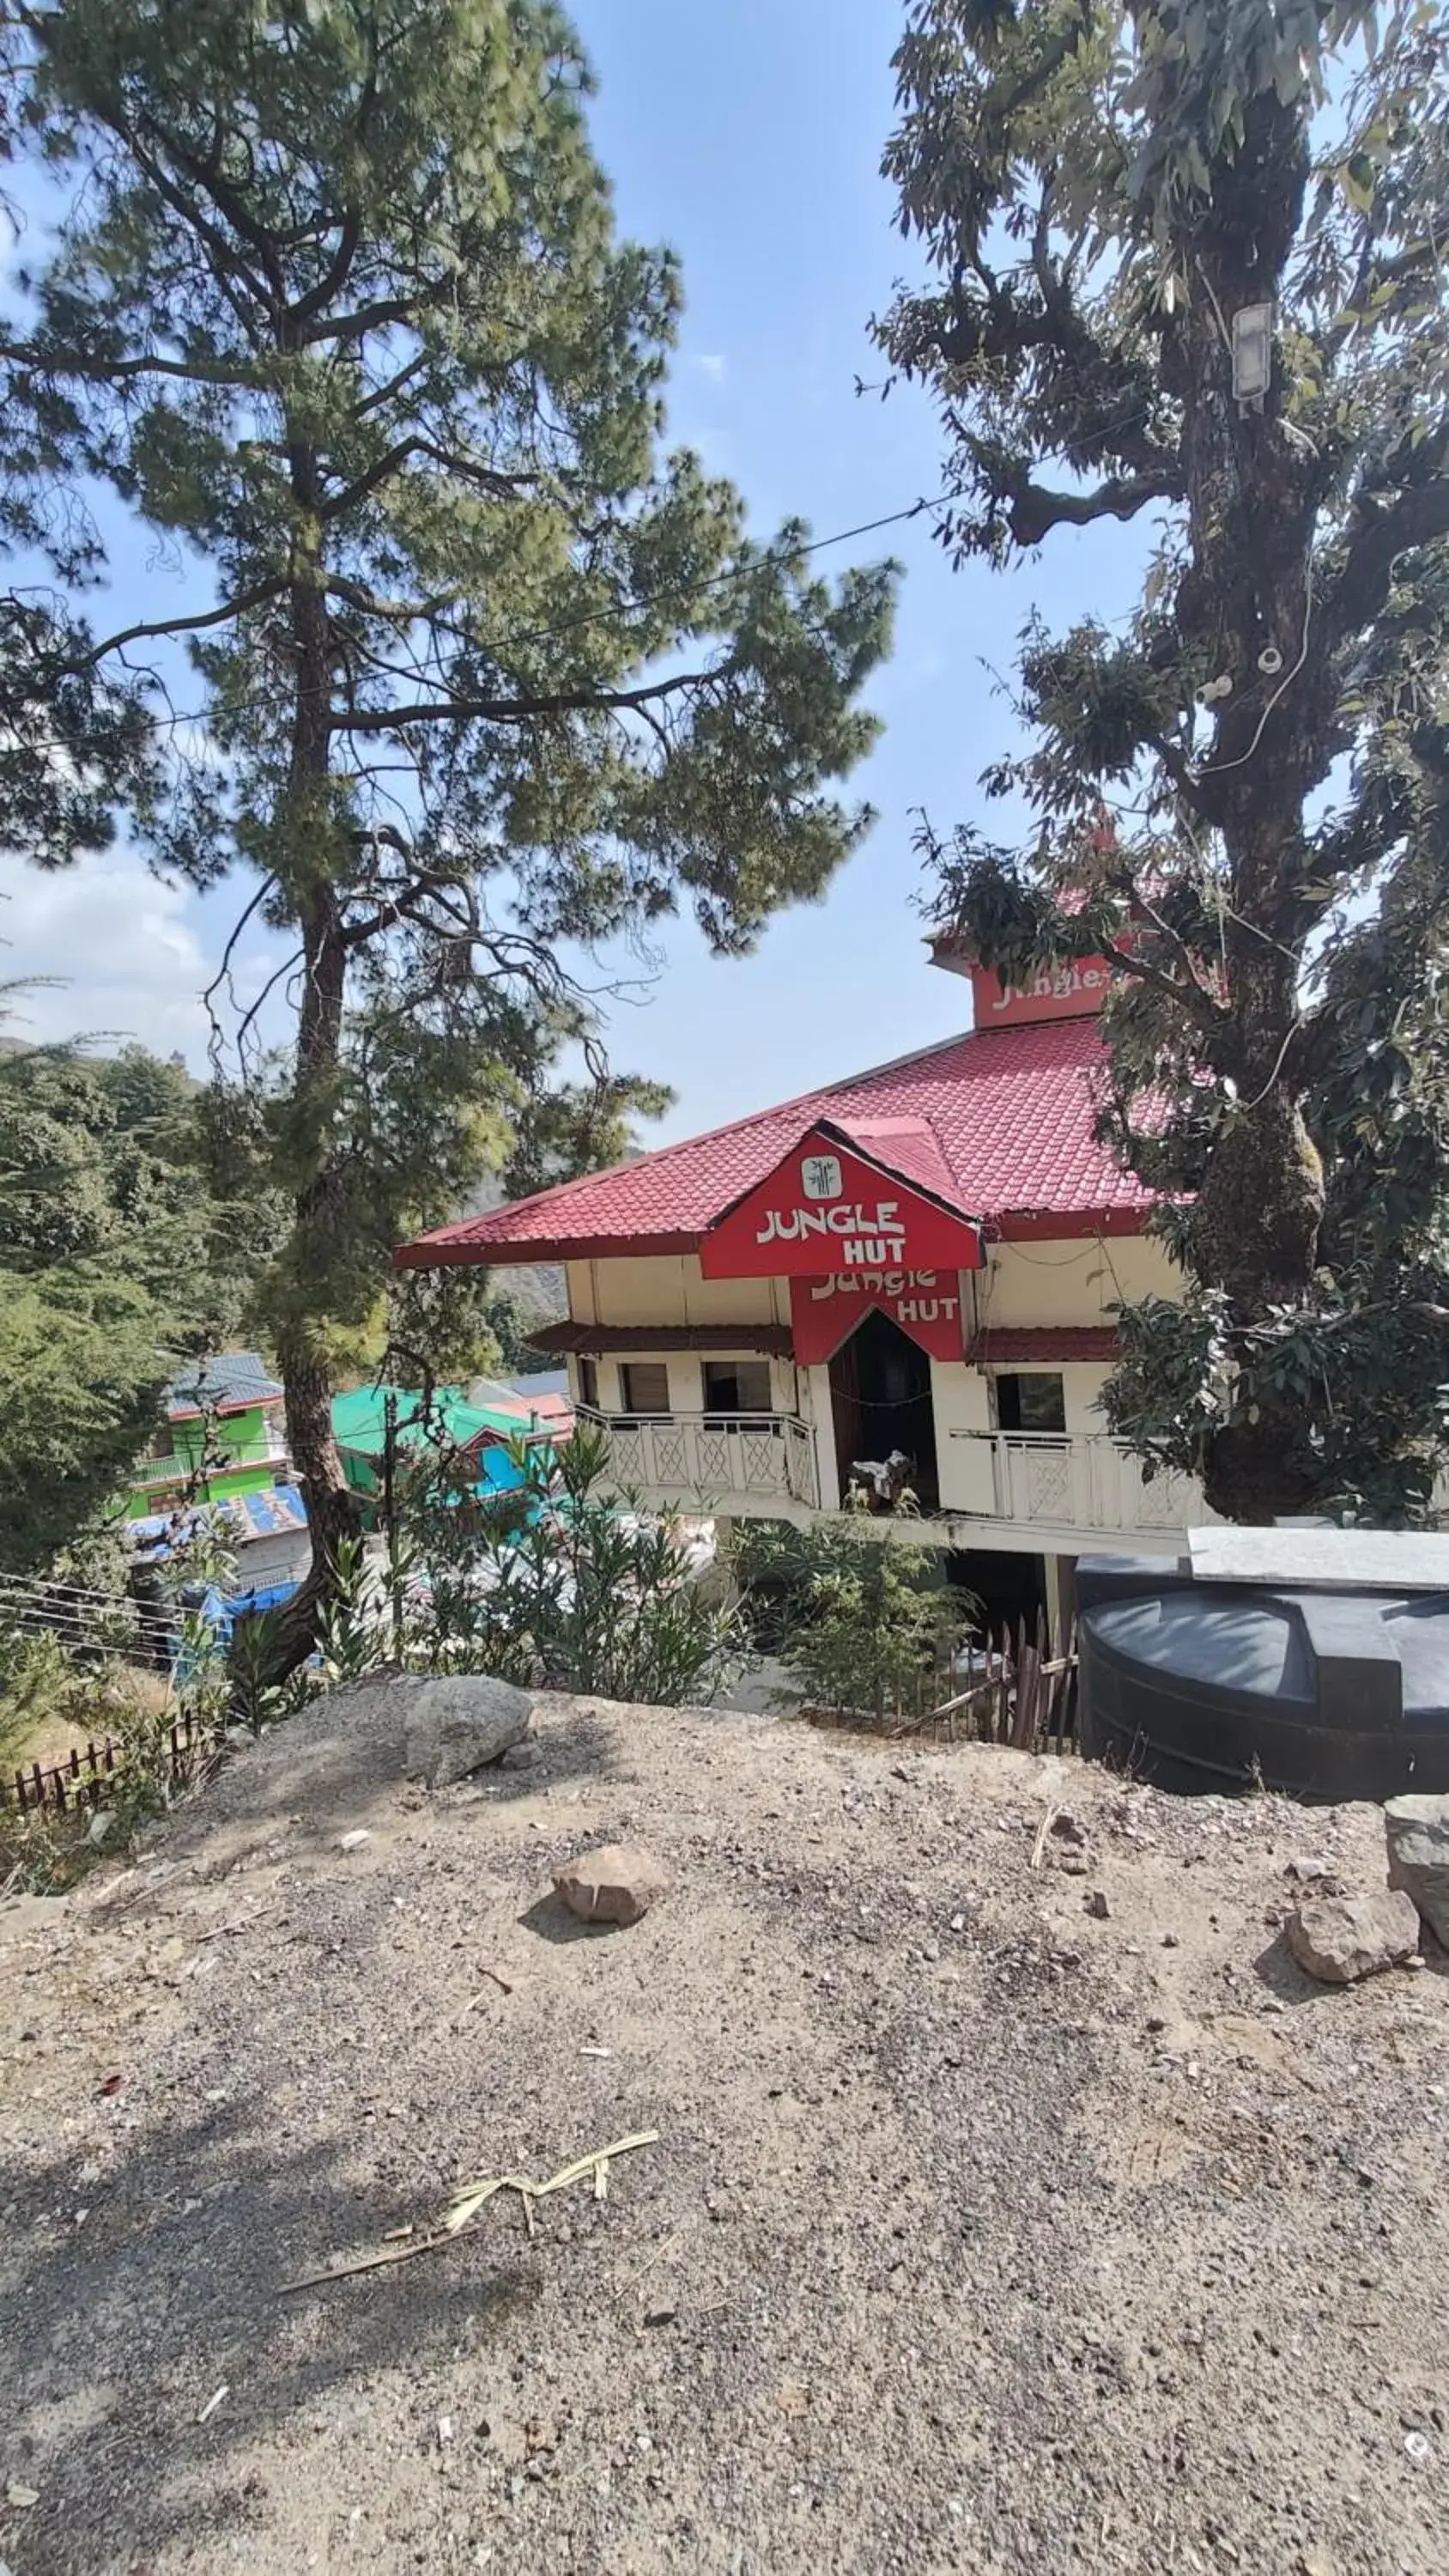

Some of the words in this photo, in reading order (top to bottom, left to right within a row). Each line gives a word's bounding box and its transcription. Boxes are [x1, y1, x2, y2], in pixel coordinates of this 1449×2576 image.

[756, 1202, 905, 1243] JUNGLE
[843, 1238, 906, 1264] HUT
[897, 1297, 958, 1321] HUT
